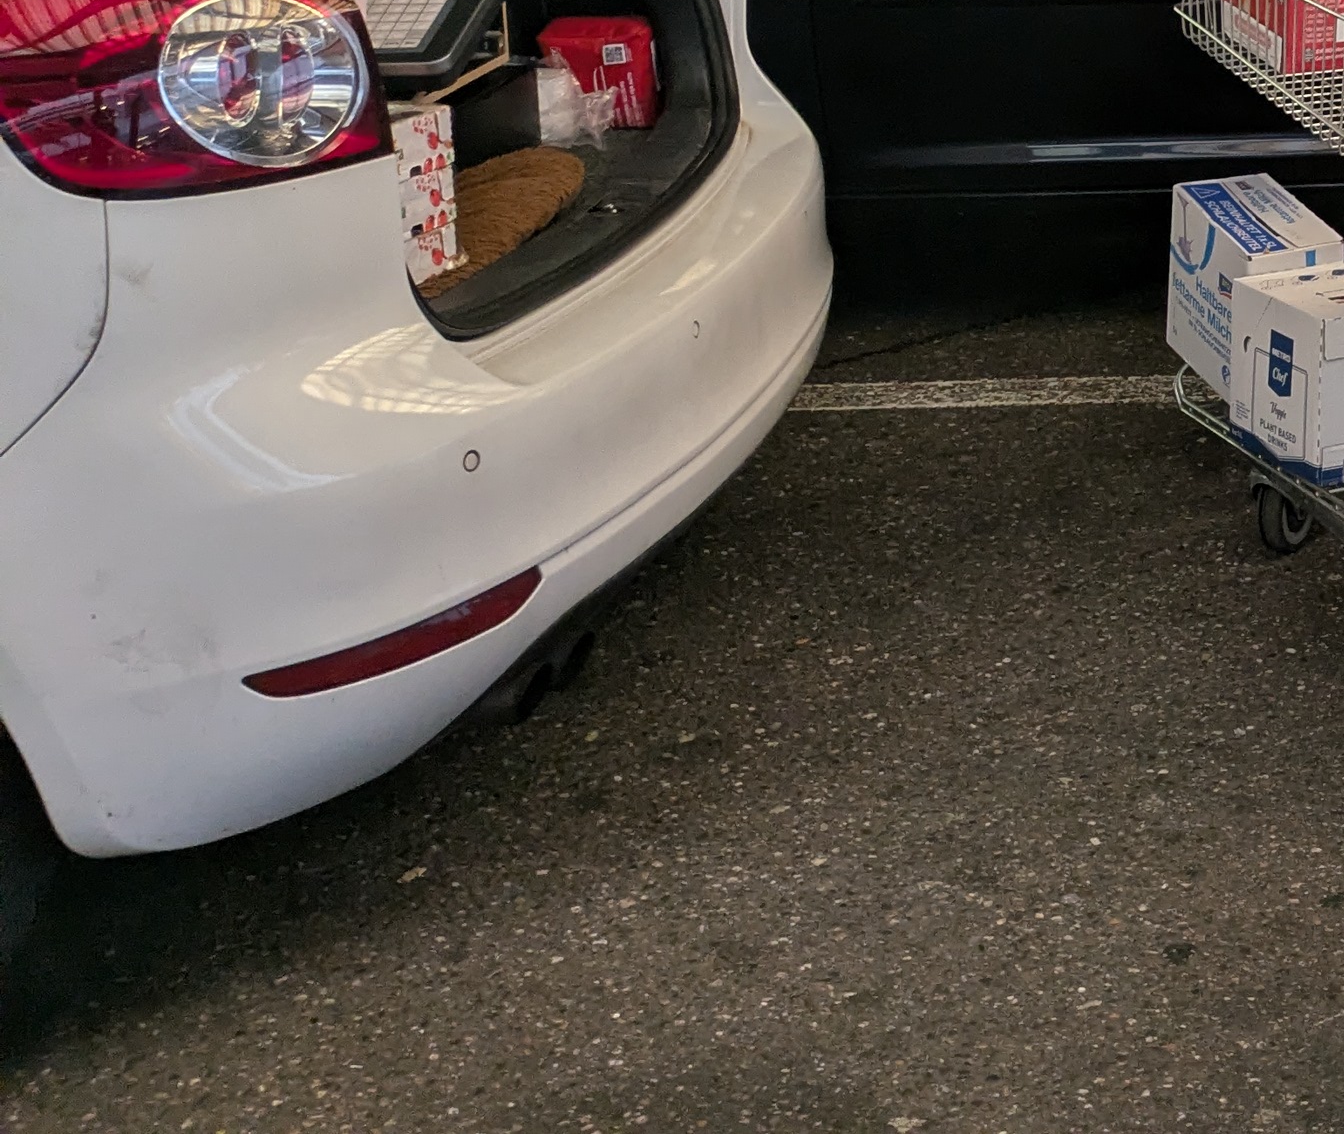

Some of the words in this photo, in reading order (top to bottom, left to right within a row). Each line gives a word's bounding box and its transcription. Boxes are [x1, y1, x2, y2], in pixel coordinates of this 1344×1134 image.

[1172, 271, 1206, 319] fettarme
[1207, 309, 1233, 342] Milch
[1195, 274, 1233, 323] Haltbare
[1272, 367, 1289, 387] Chef
[1259, 418, 1278, 435] PLANT
[1278, 427, 1297, 444] BASED
[1267, 433, 1288, 452] DRINKS
